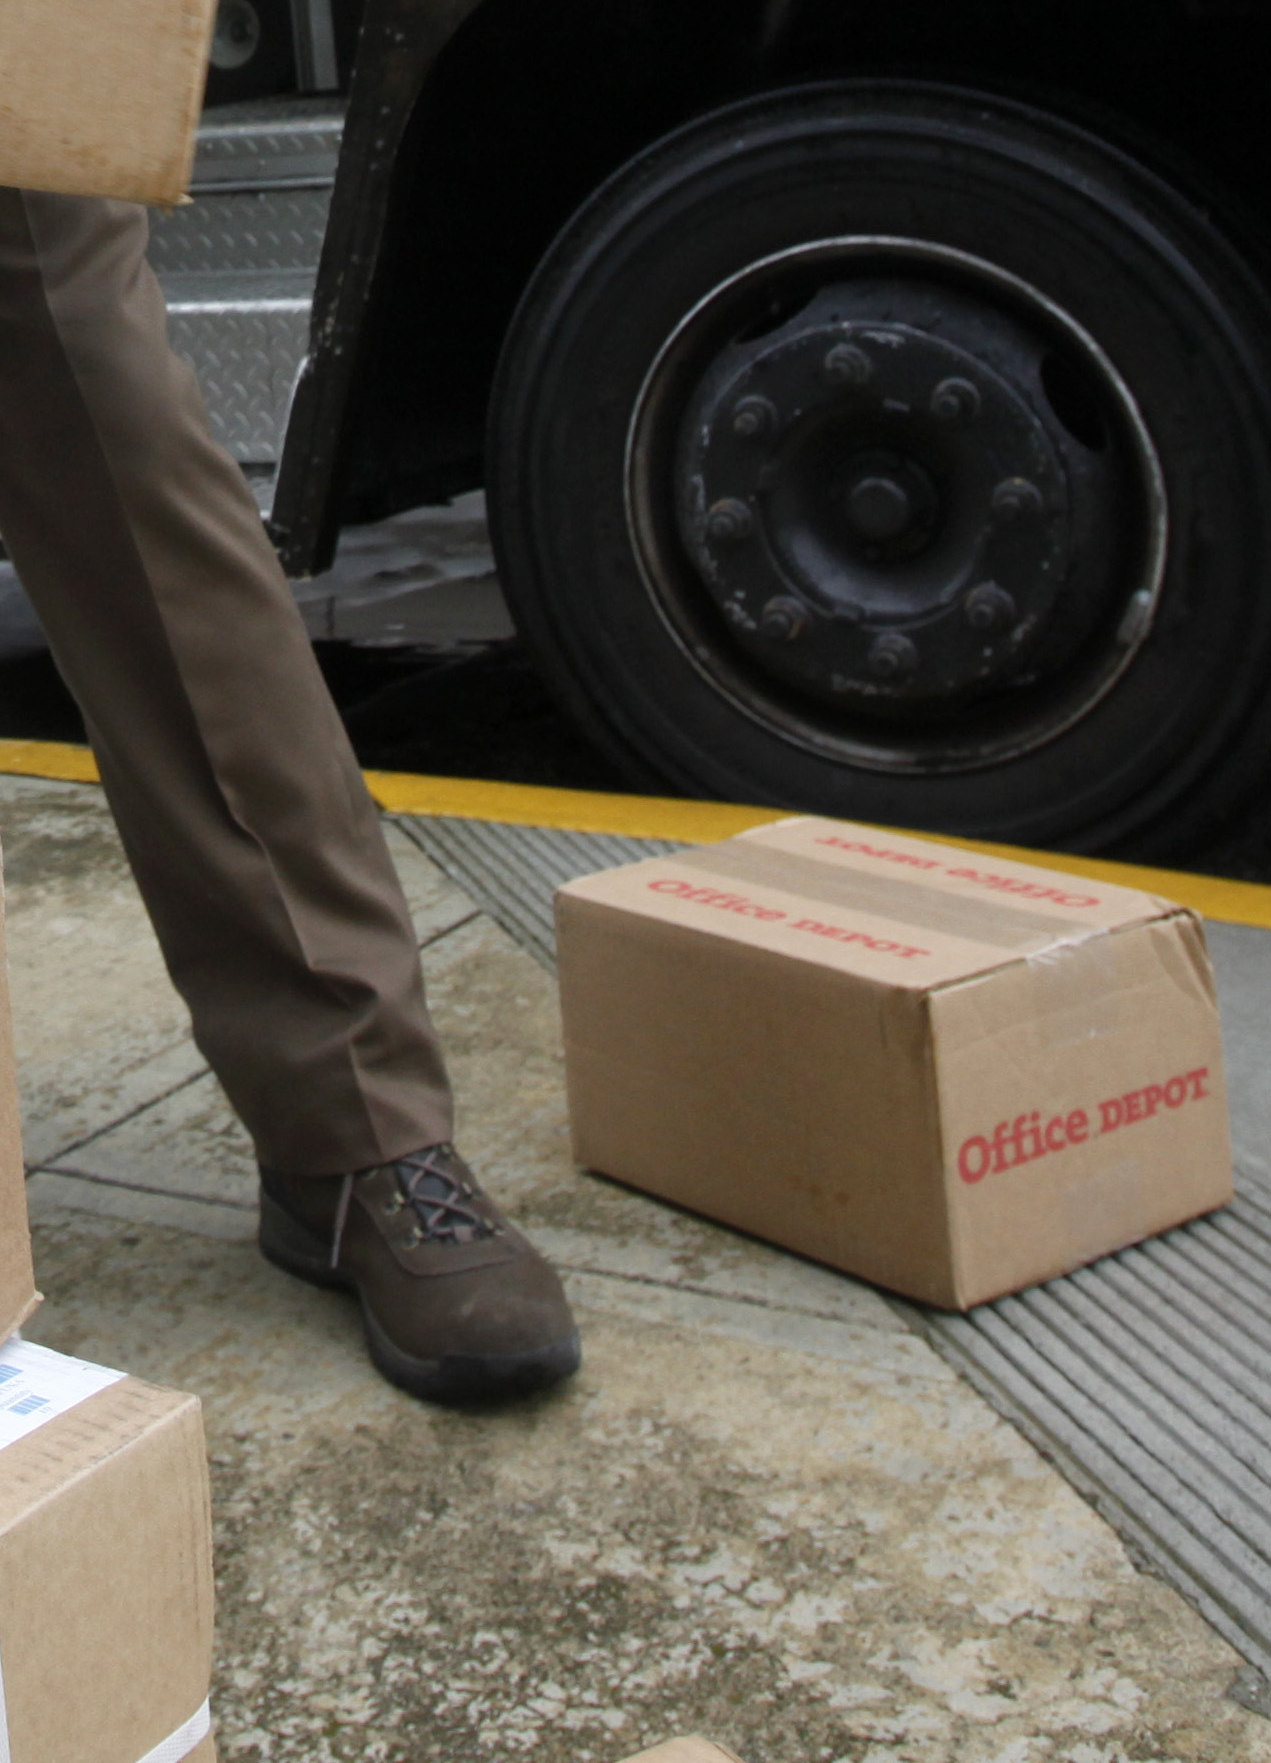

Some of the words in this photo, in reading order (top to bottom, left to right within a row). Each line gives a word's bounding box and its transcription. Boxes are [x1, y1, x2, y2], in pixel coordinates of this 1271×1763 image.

[815, 836, 941, 869] DEPOT
[945, 865, 1102, 909] Office
[647, 878, 787, 924] Office
[788, 919, 931, 962] DEPOT
[957, 1107, 1091, 1187] Office
[1098, 1066, 1210, 1136] DEPOT
